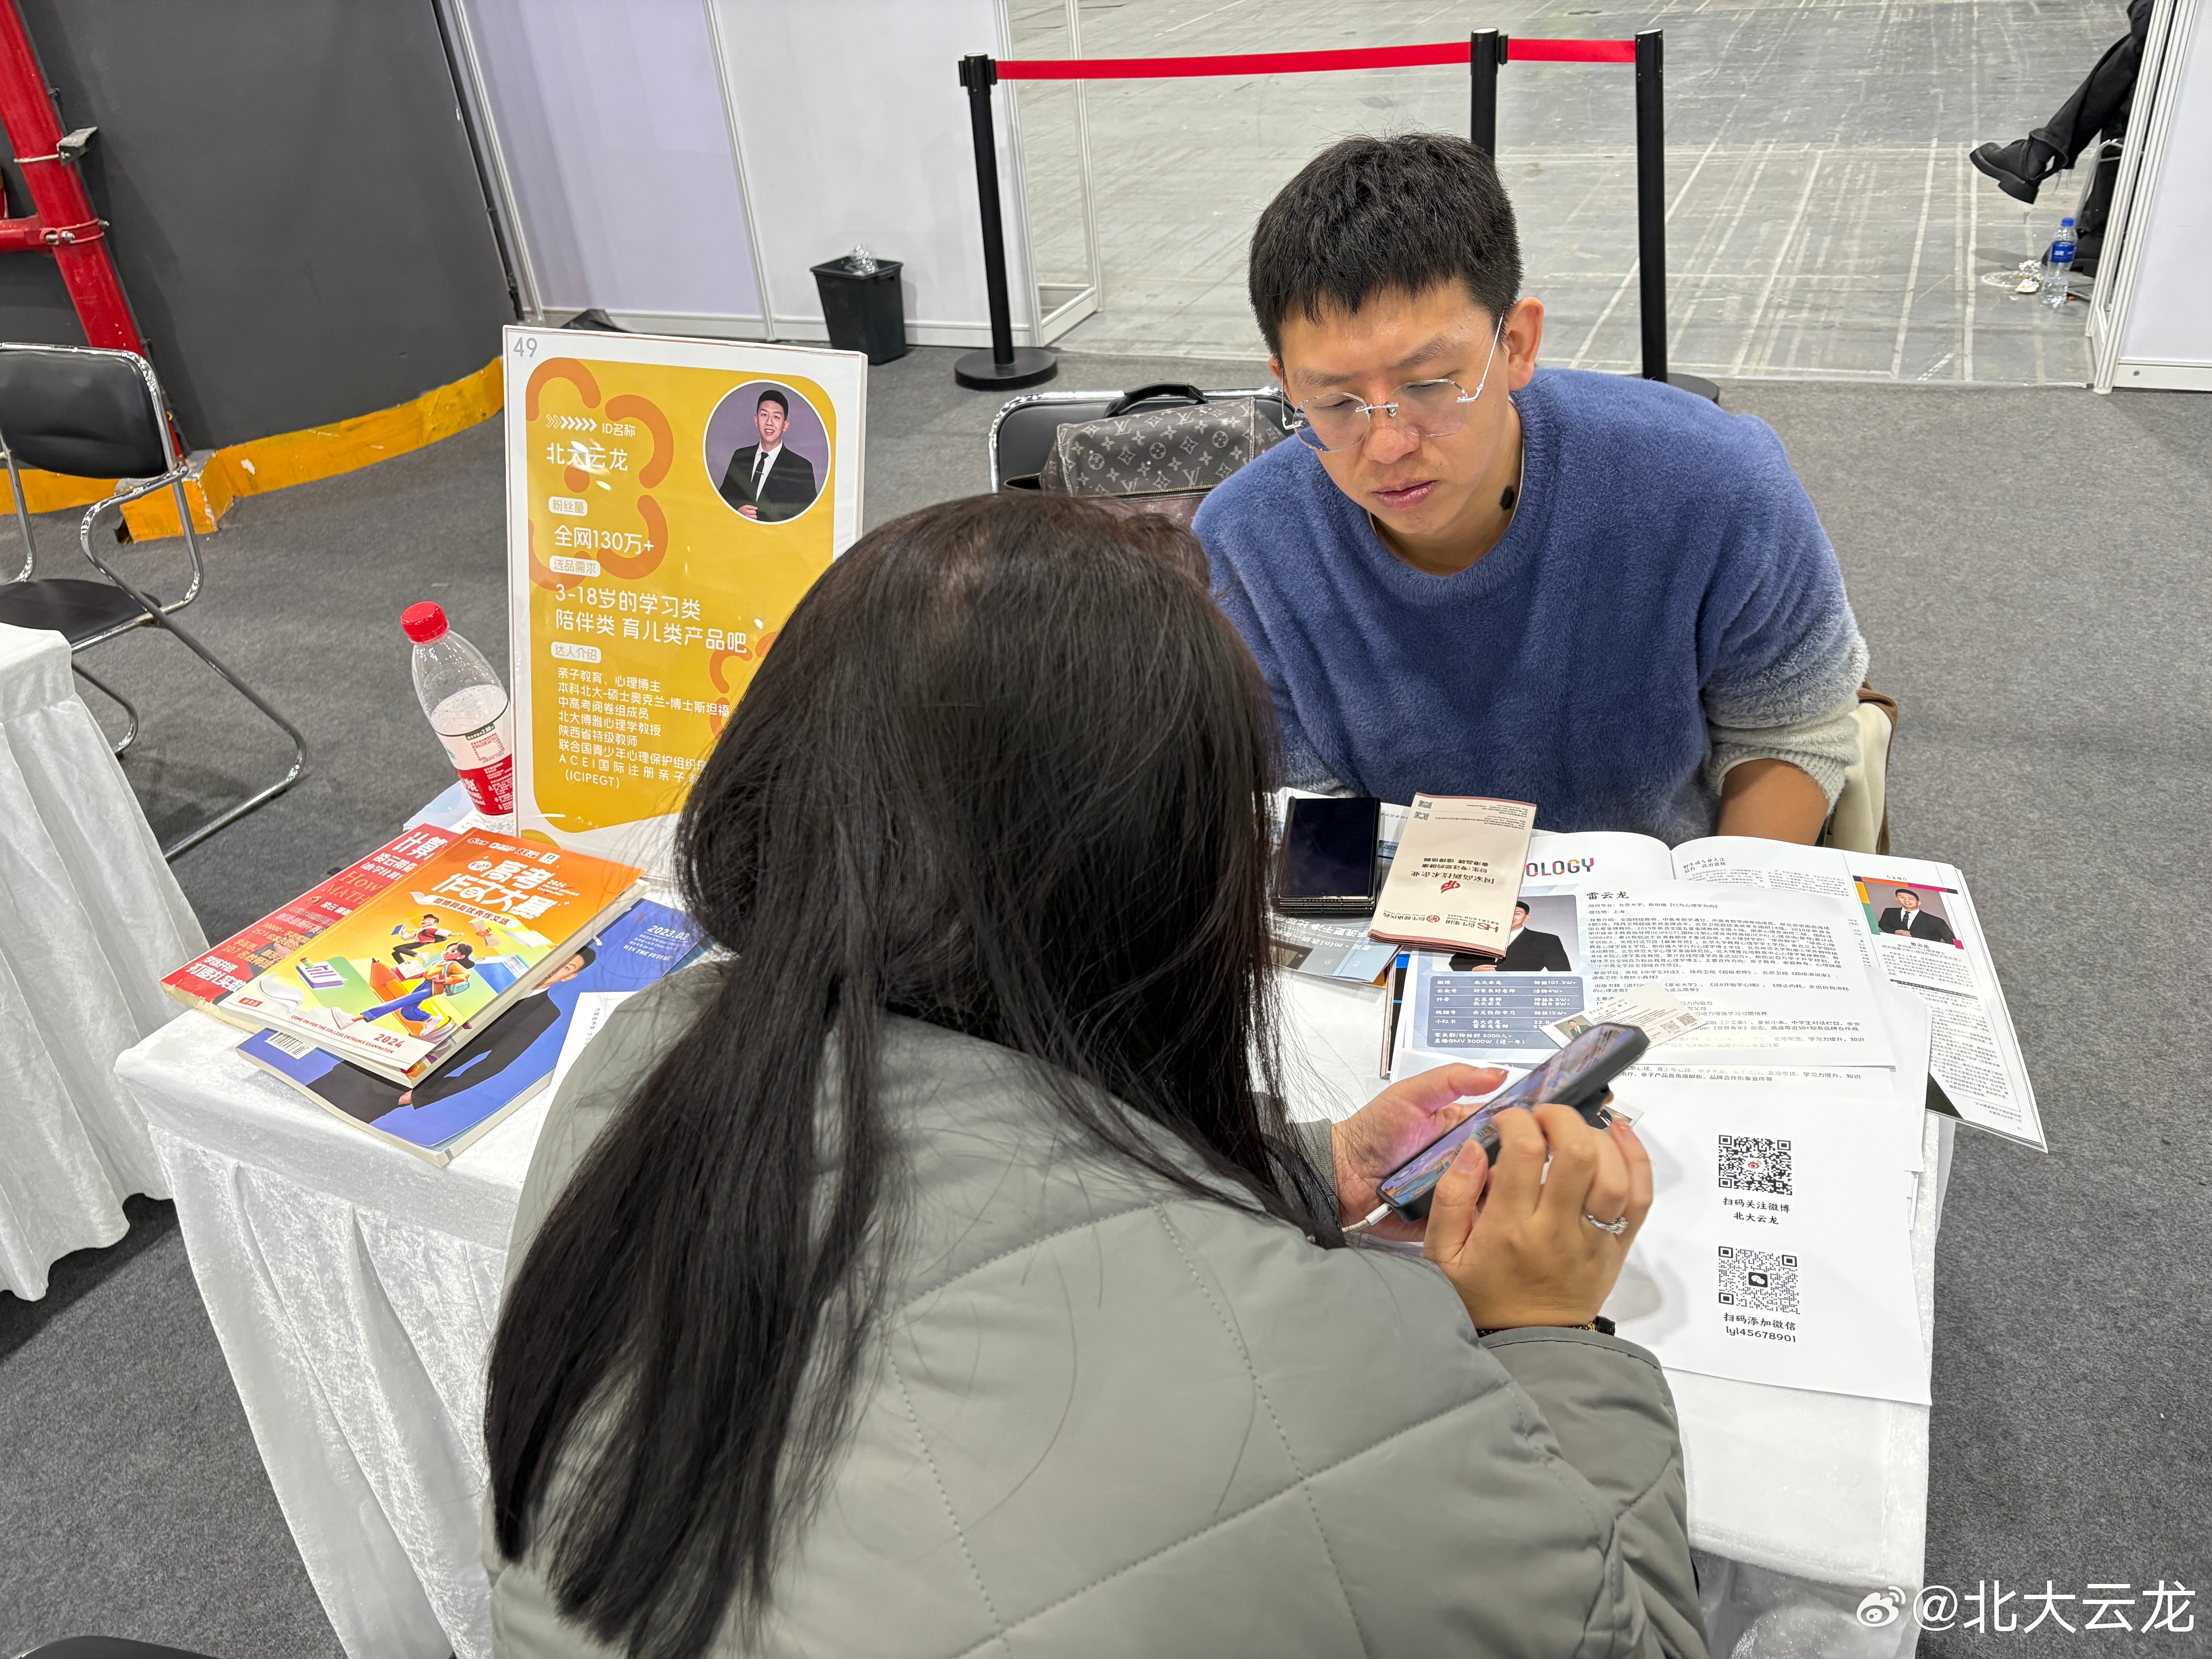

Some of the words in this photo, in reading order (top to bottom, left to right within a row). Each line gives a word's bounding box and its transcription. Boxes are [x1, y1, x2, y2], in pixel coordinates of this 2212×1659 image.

[513, 337, 538, 358] 49
[601, 424, 636, 438] ID名称
[546, 442, 629, 472] 北大云龙
[552, 498, 586, 514] 粉丝量
[554, 524, 655, 554] 全网130万+
[553, 559, 597, 574] 选品需求
[555, 583, 701, 621] 3-18岁的学习类
[555, 609, 615, 637] 陪伴类
[623, 617, 747, 654] 育儿类产品吧
[555, 645, 597, 661] 达人介绍
[558, 697, 649, 720] 中高考阅卷组成员
[558, 710, 661, 737] 北大博雅心理学教授
[559, 725, 638, 747] 陕西省特级教师
[392, 831, 448, 860] 计算
[480, 860, 556, 889] 高考
[1411, 871, 1494, 884] 国家高新技术企业
[1525, 858, 1594, 877] OLOGY
[431, 873, 558, 919] 作文大赛
[1586, 891, 1630, 900] 雷云龙
[326, 1028, 344, 1038] COLLEGE
[343, 1034, 366, 1045] ENTRANCE
[365, 1041, 394, 1054] EXAMINATION
[374, 1034, 405, 1048] 2024
[1723, 1197, 1791, 1213] 扫码关注微博
[1733, 1212, 1779, 1225] 北大云龙
[1723, 1312, 1797, 1331] 扫码添加微信
